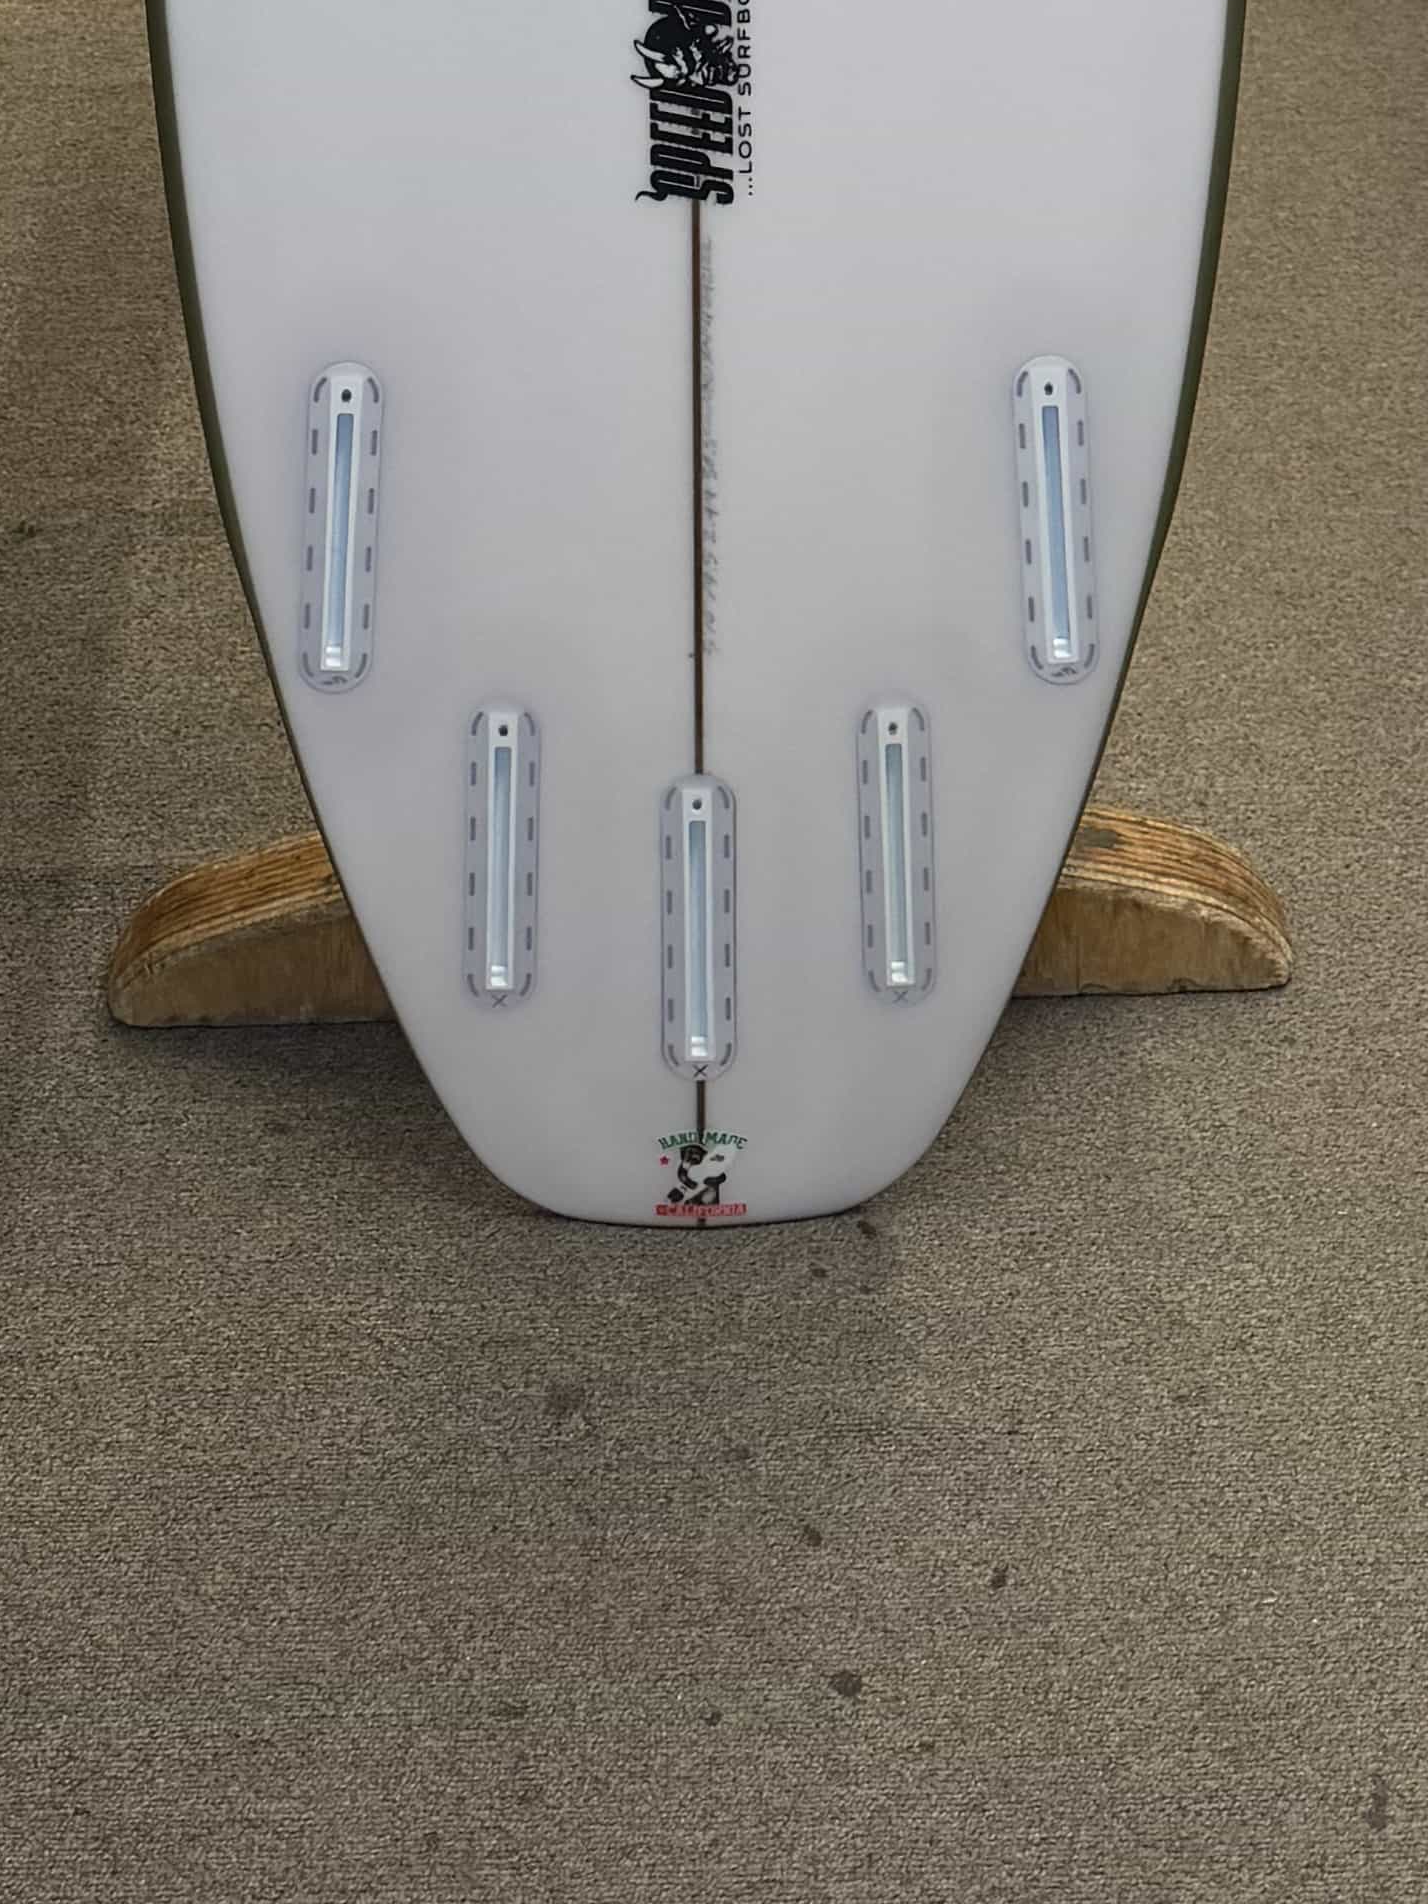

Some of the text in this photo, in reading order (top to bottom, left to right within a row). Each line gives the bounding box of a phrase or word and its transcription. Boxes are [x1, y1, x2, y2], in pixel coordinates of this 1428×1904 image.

[635, 87, 734, 205] SPEED
[658, 1130, 749, 1150] HAND MADE
